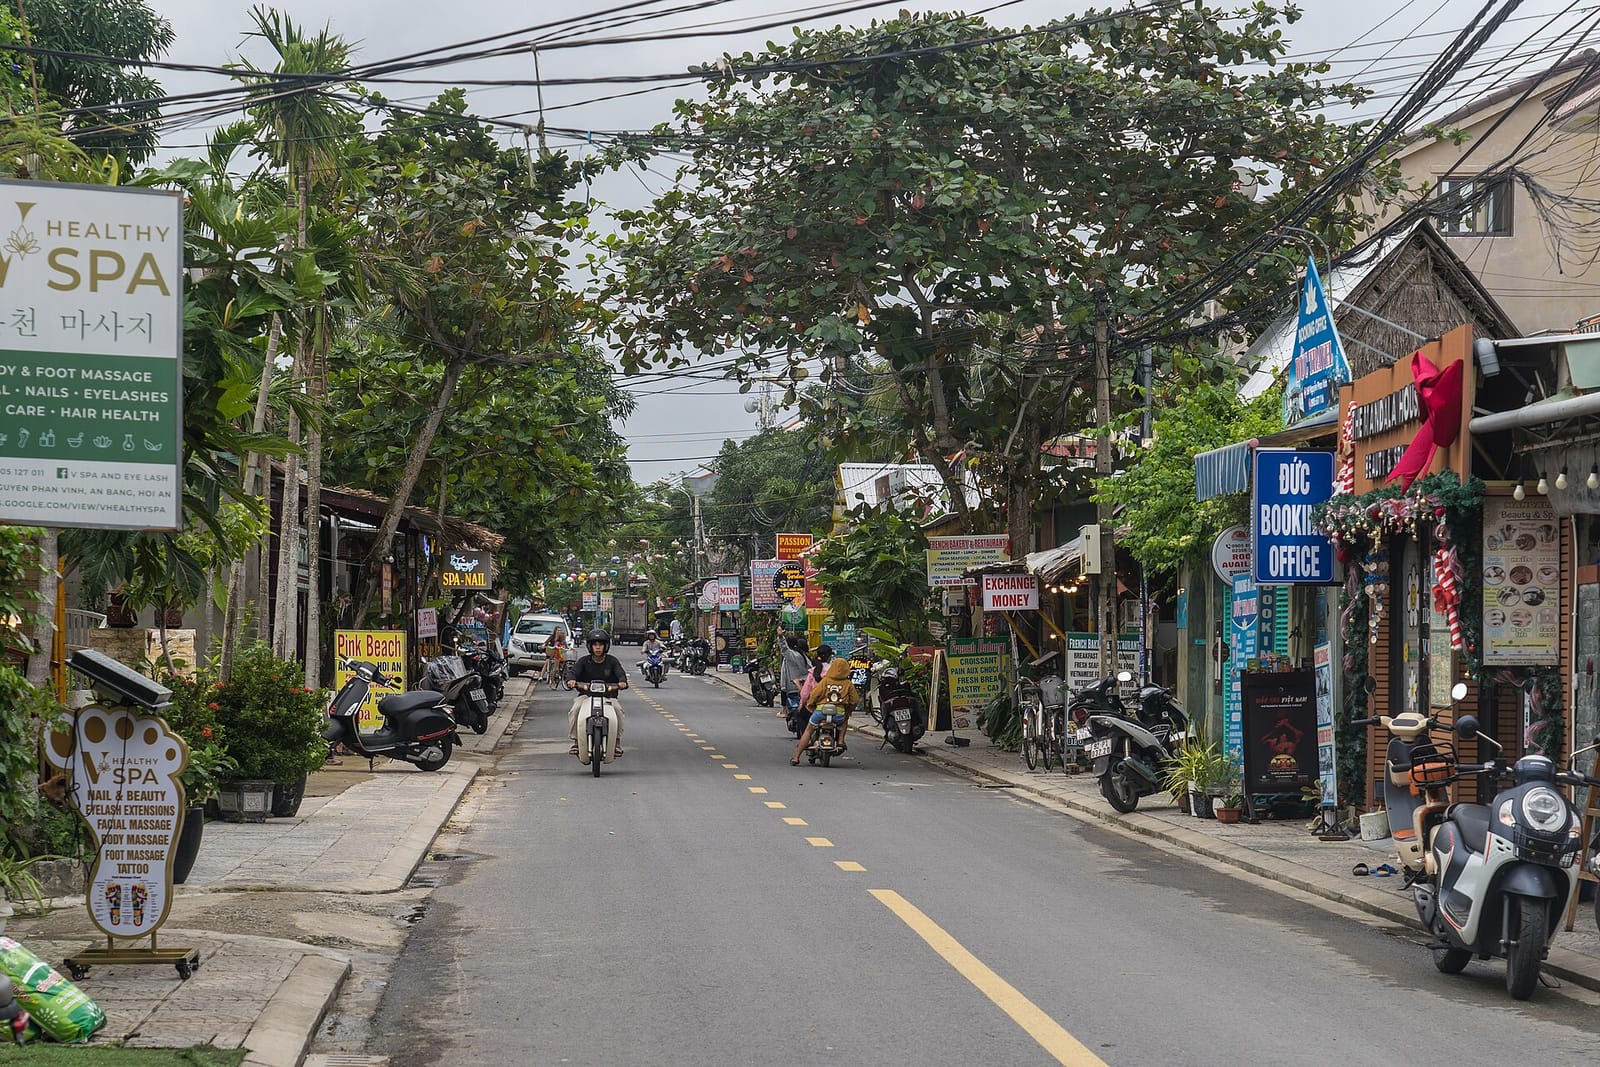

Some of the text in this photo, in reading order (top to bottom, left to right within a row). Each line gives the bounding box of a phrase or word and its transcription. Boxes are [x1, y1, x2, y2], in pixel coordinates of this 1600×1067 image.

[47, 220, 170, 242] HEALTHY
[47, 247, 171, 296] SPA
[60, 309, 152, 344] 마사지
[36, 367, 77, 379] FOOT
[81, 369, 152, 383] MASSAGE
[25, 386, 69, 398] NAILS
[84, 388, 168, 402] EYELASHES
[6, 404, 160, 422] CARE HAIR HEALTH
[80, 472, 98, 480] SPA
[101, 472, 120, 480] AND
[124, 473, 141, 481] EYE
[144, 474, 168, 482] LASH
[1280, 456, 1311, 495] ĐỨC
[1261, 504, 1320, 536] BOOKIN
[779, 538, 810, 546] PASSION
[1269, 546, 1320, 577] OFFICE
[780, 580, 802, 588] SPA
[986, 577, 1036, 590] EXCHANGE
[720, 587, 738, 596] MINI
[992, 594, 1030, 608] MONEY
[338, 634, 362, 657] Pink
[366, 634, 401, 657] Beach
[1069, 638, 1087, 648] FRENCH
[392, 662, 402, 672] AN
[960, 657, 997, 666] CROISSANT
[113, 768, 158, 784] SPA
[88, 790, 166, 800] NAIL & BEAUTY
[86, 805, 175, 816] EYELASH EXTENSIONS
[98, 820, 172, 830] FACIAL MASSAGE
[101, 834, 168, 845] BODY MASSAGE
[105, 850, 164, 861] FOOT MASSAGE
[117, 864, 149, 874] TATTOO
